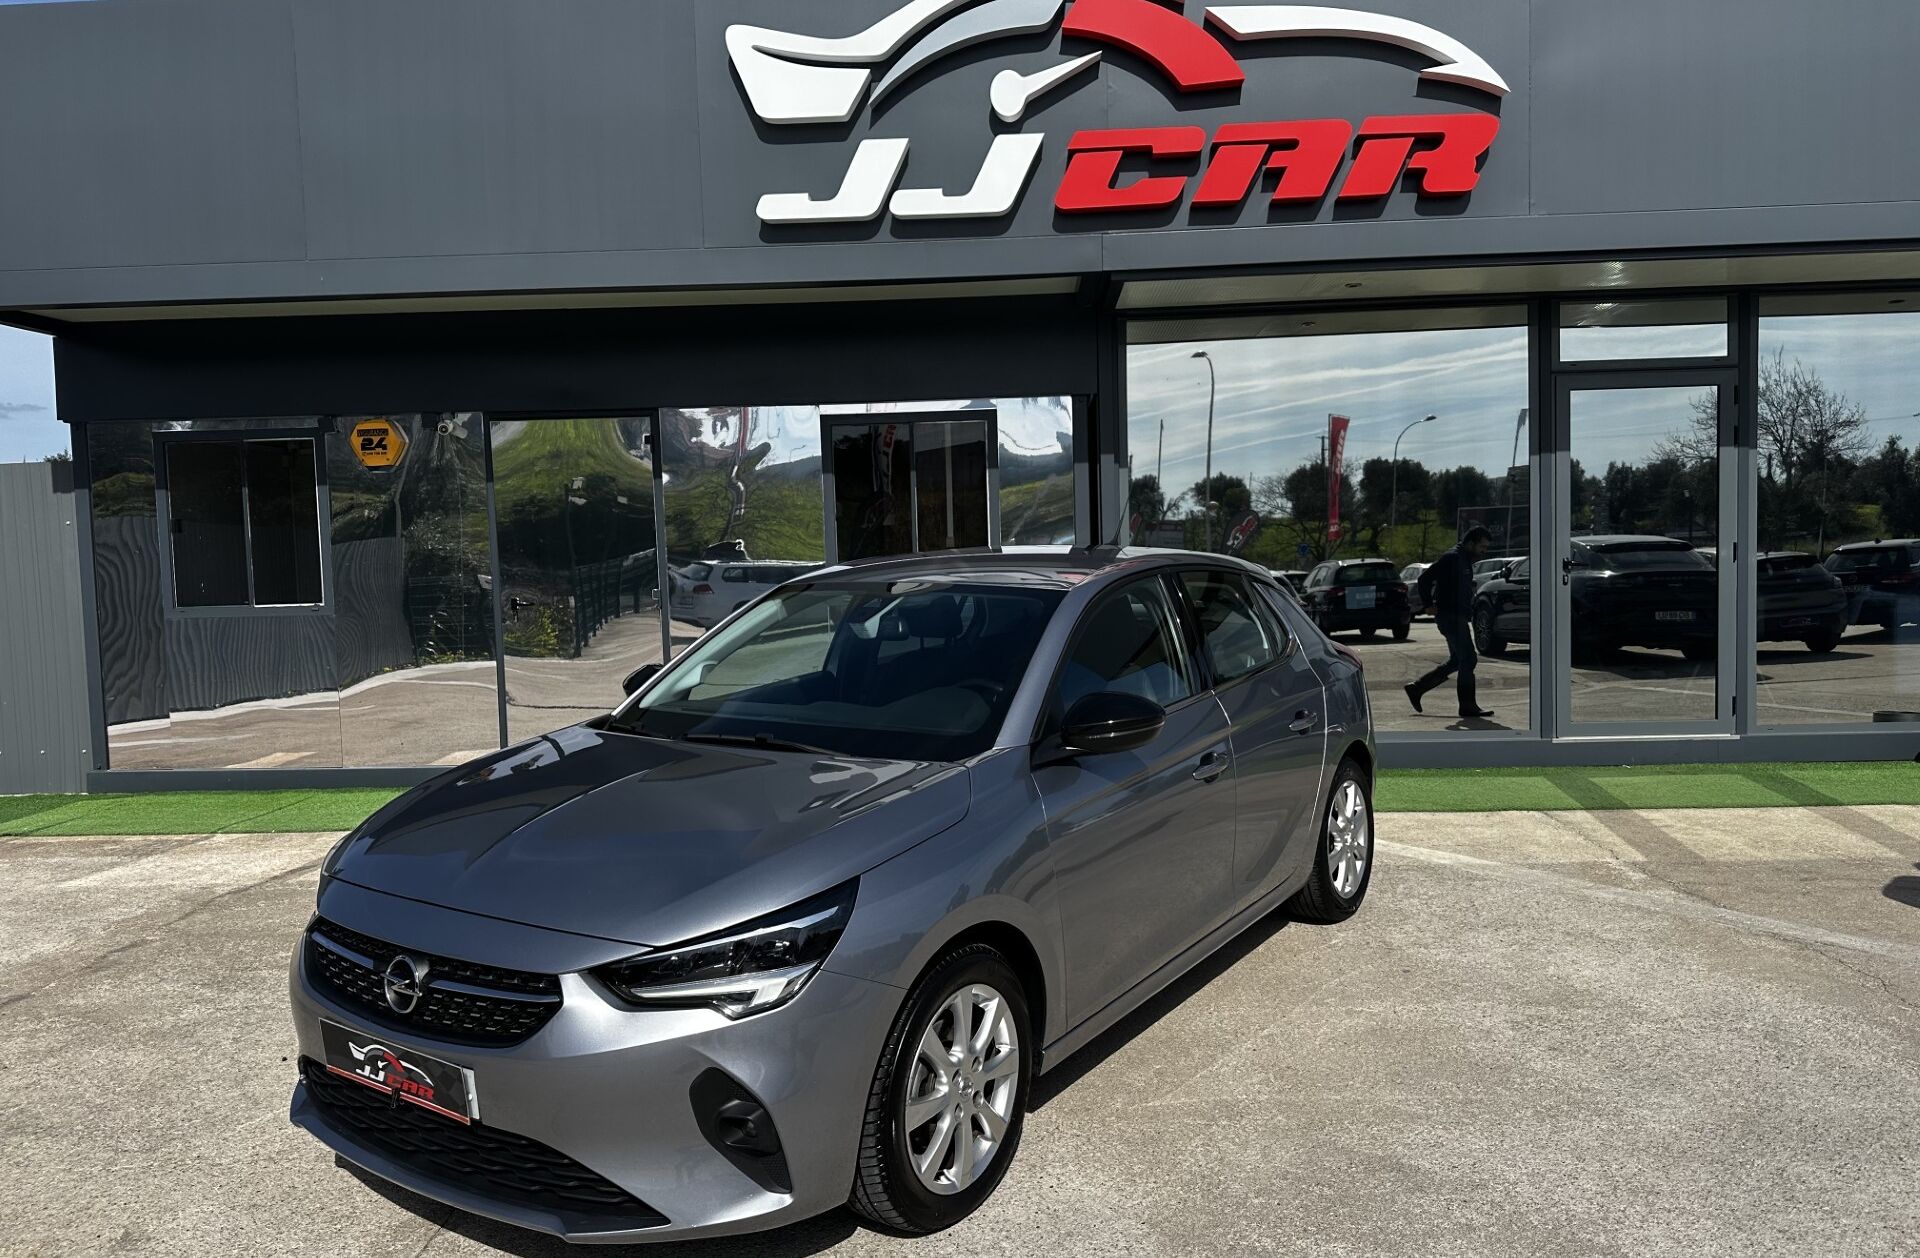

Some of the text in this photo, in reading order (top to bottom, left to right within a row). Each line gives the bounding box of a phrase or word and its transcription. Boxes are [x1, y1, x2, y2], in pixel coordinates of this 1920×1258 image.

[1053, 113, 1501, 213] CAR
[361, 437, 388, 451] 24
[386, 1073, 434, 1099] CAR
